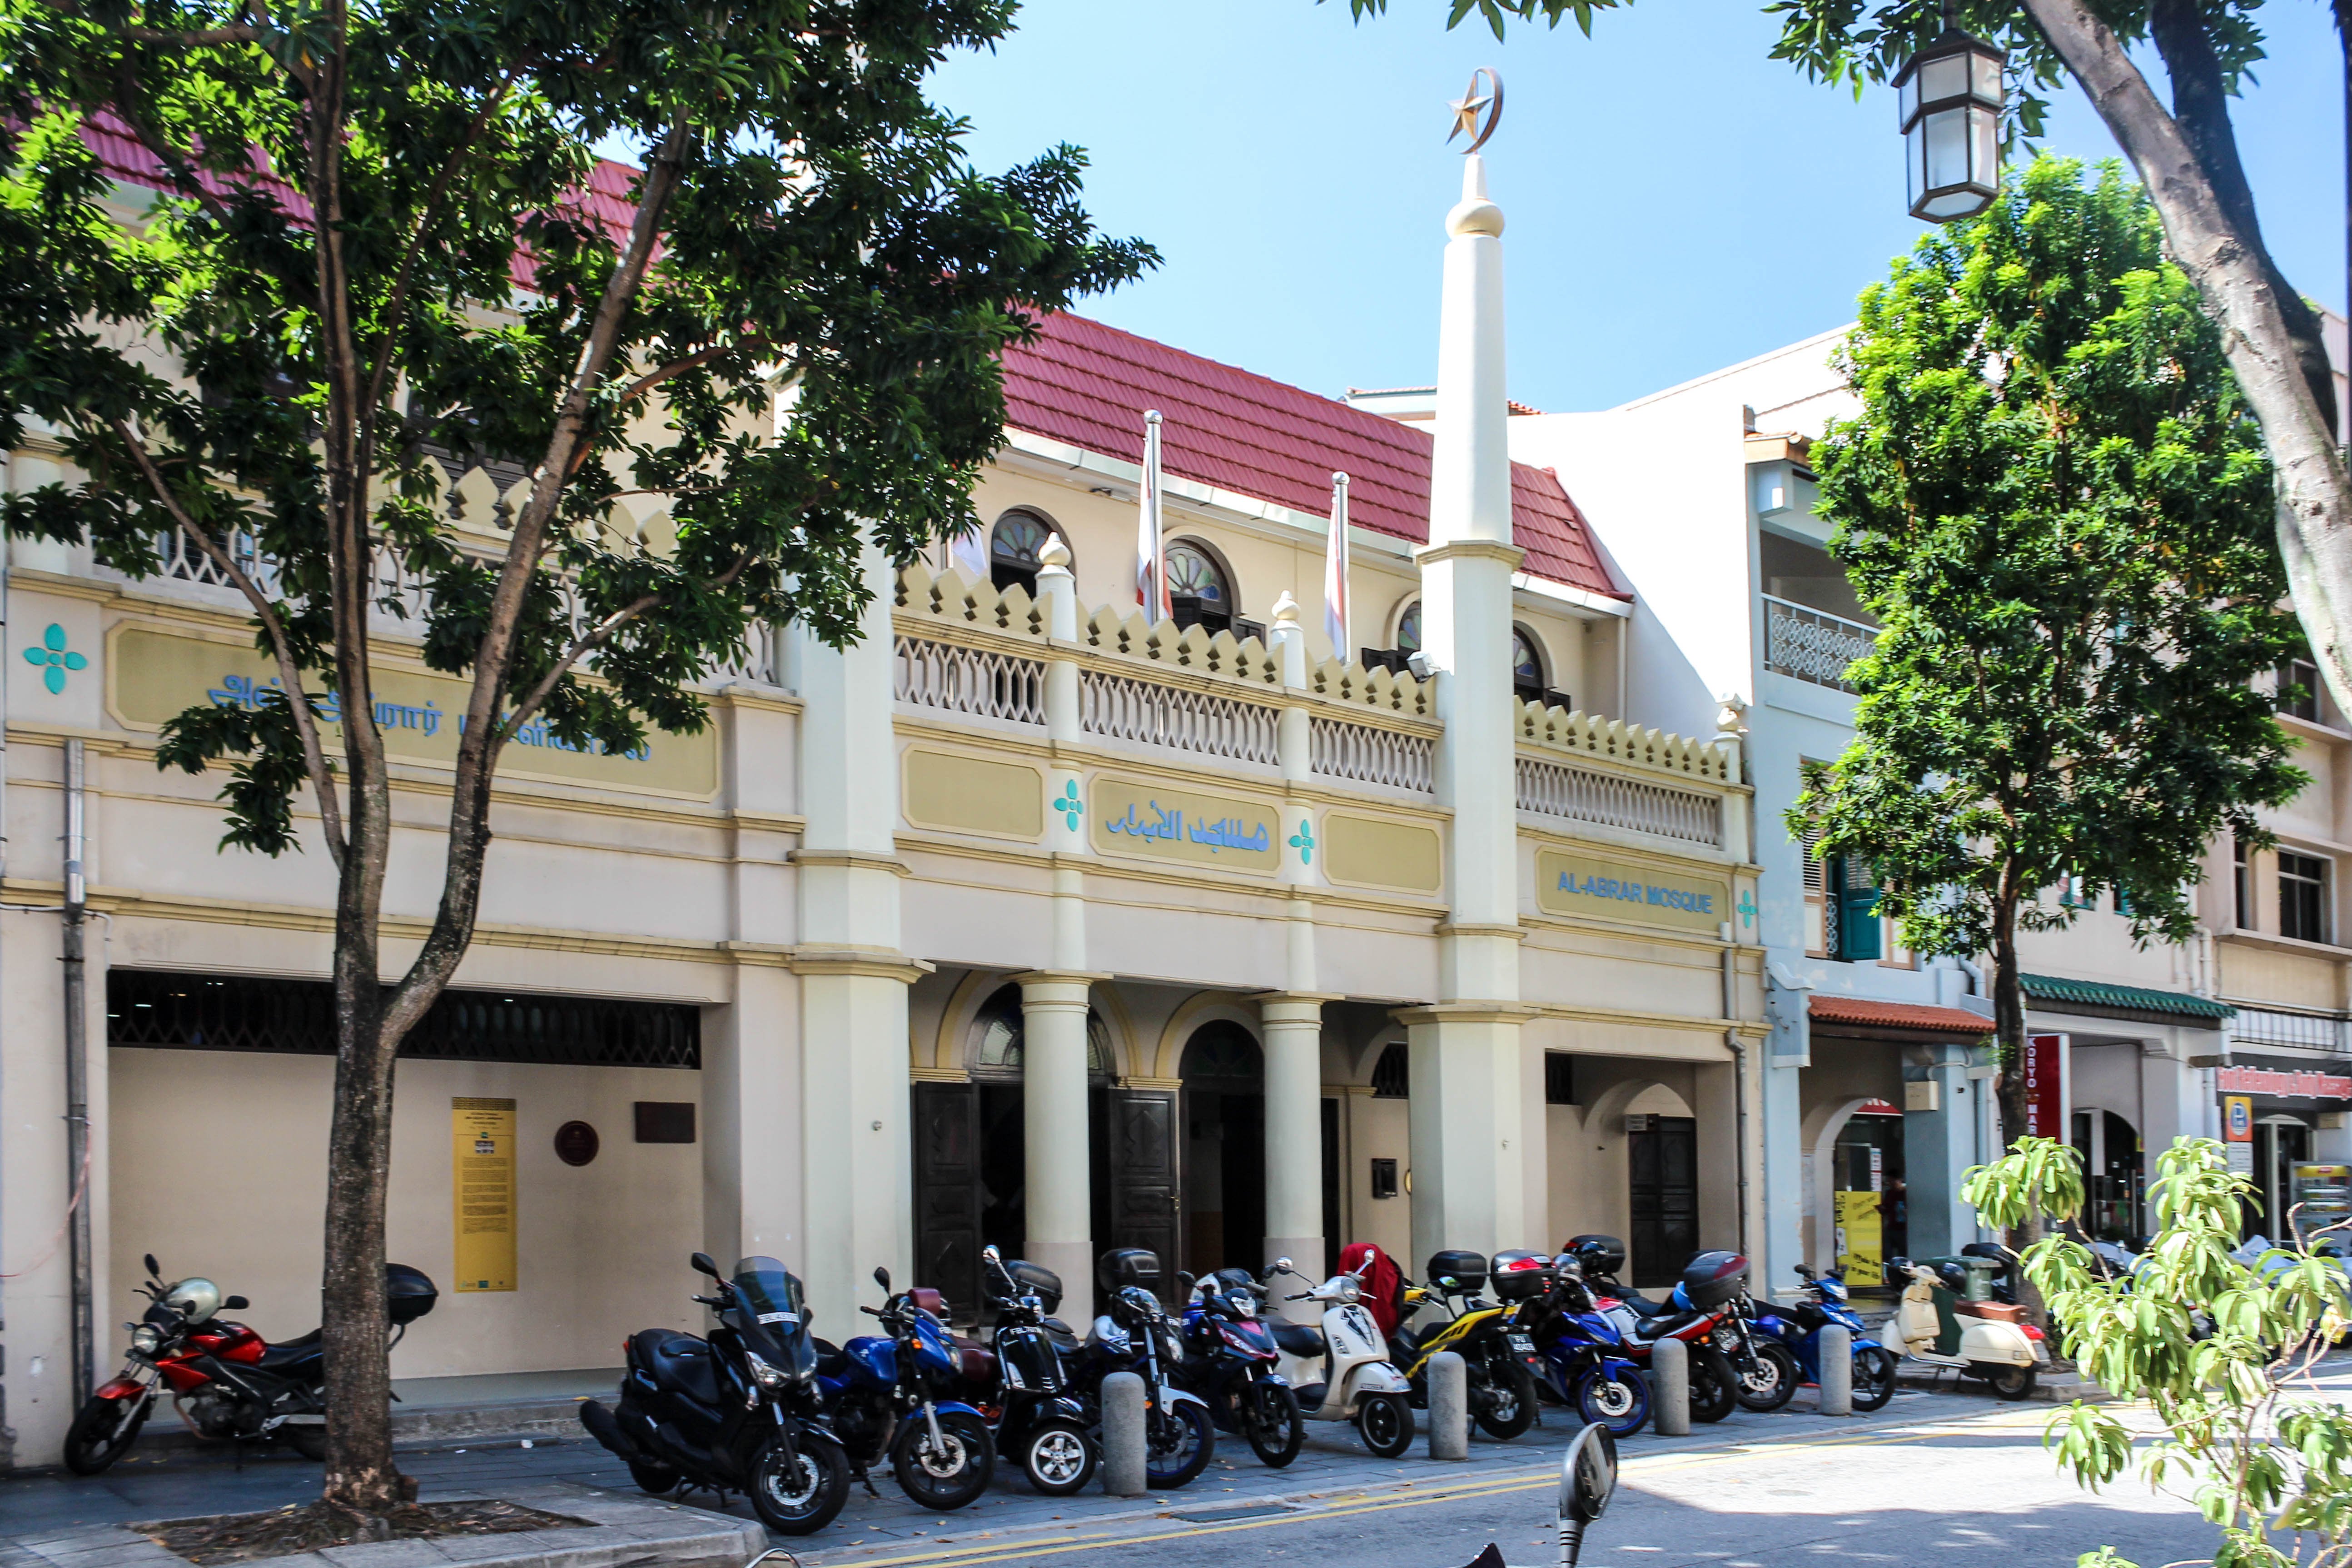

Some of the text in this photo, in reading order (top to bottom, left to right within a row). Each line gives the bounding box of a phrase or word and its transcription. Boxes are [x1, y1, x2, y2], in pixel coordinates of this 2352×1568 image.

[1558, 871, 1713, 914] AL-ABRAR MOSQUE
[2027, 1037, 2038, 1137] KORYO MAR
